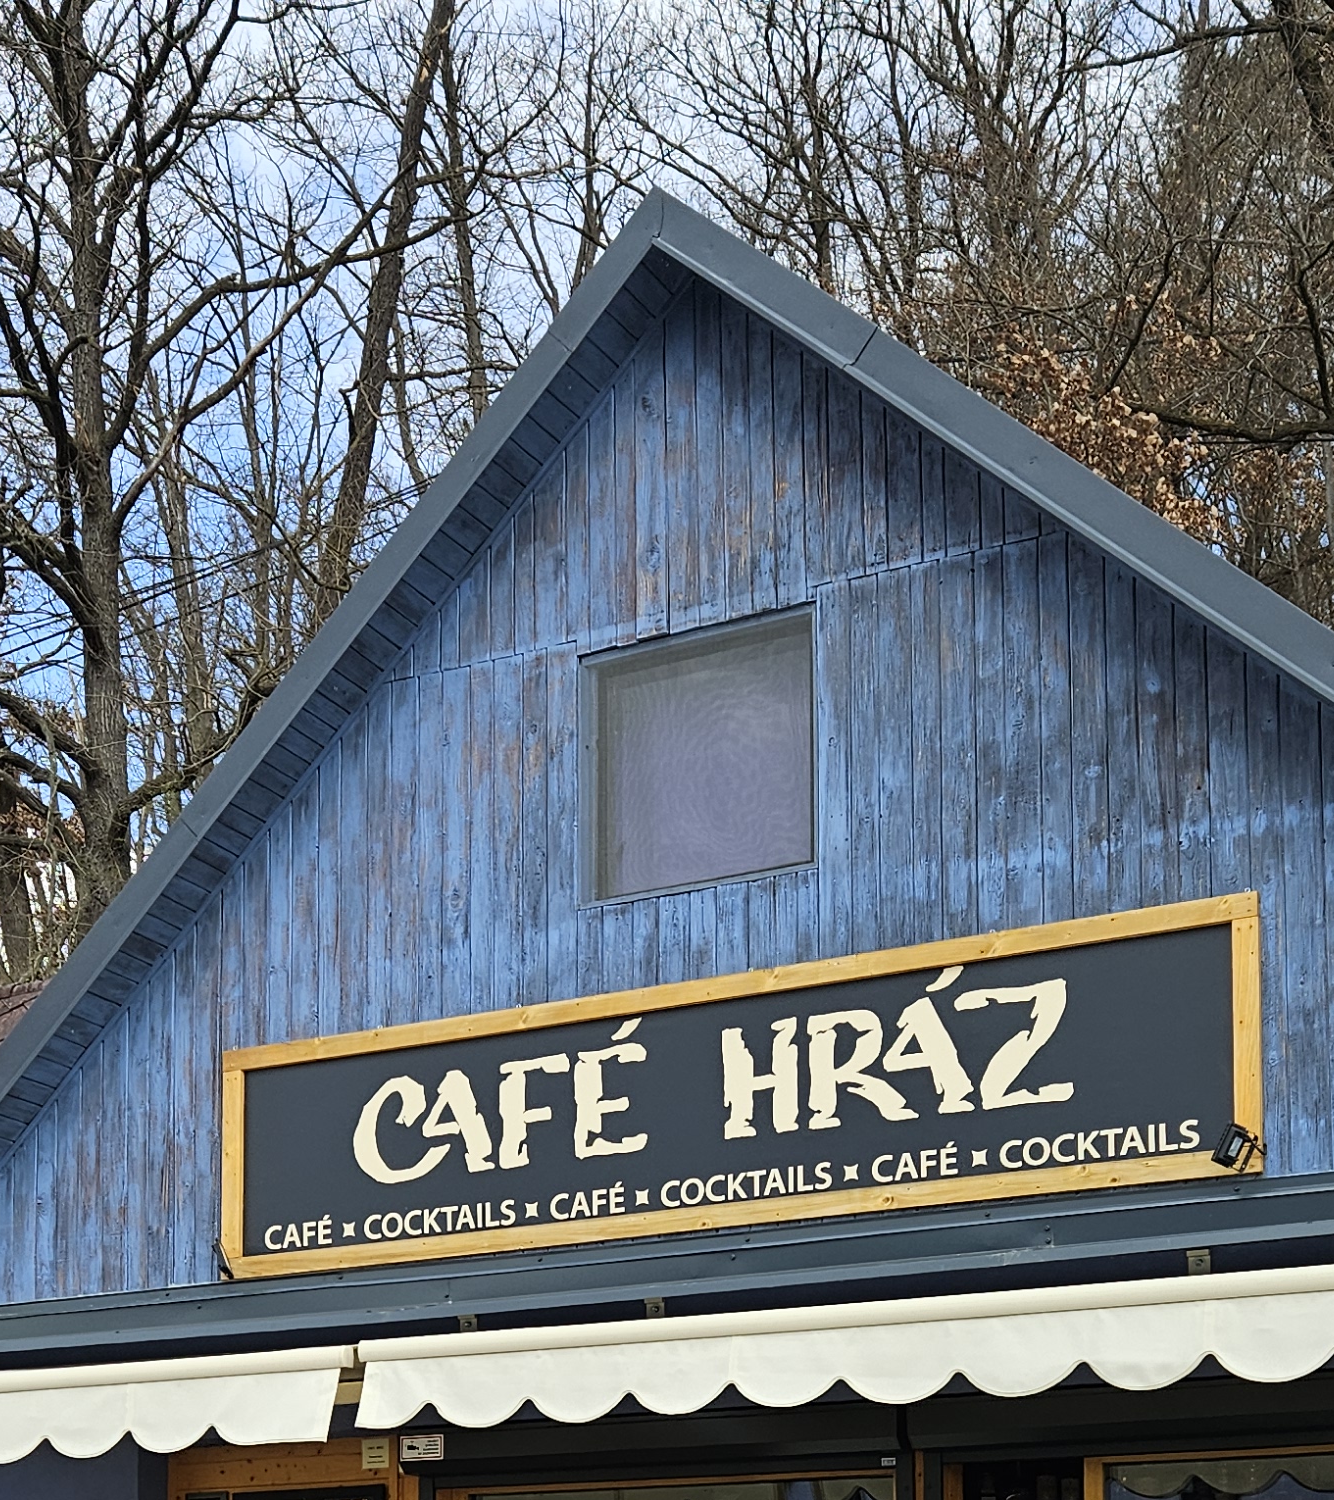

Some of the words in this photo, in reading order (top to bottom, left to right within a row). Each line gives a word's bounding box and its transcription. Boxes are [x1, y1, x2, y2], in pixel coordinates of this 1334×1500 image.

[353, 1017, 648, 1184] CAFÉ
[722, 965, 1074, 1140] HRÁZ
[264, 1214, 333, 1251] CAFÉ
[363, 1199, 516, 1240] COCKTAILS
[549, 1181, 625, 1221] CAFÉ
[660, 1161, 834, 1208] COCKTAILS
[871, 1141, 959, 1183] CAFÉ
[999, 1119, 1201, 1169] COCKTAILS
